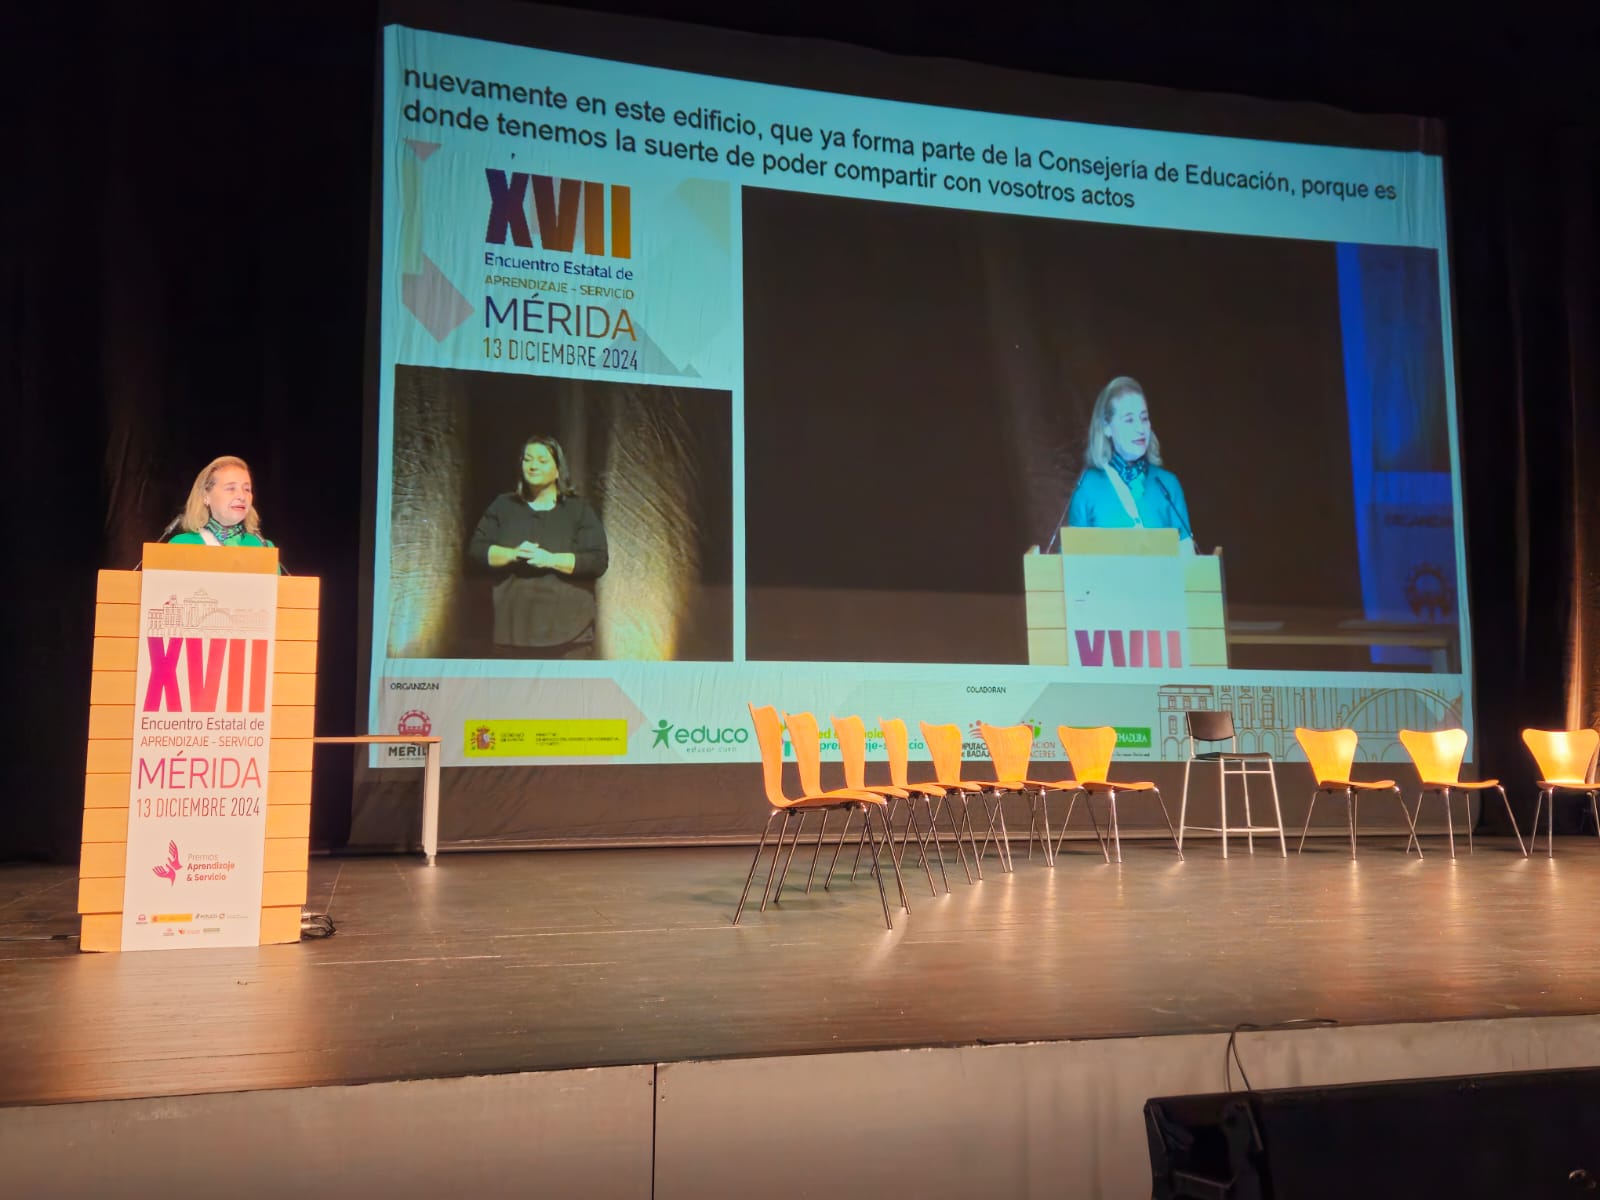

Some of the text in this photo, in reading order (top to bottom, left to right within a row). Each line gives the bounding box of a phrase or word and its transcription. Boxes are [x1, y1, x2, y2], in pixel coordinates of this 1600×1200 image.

[403, 68, 1398, 202] nuevamente en este edificio, que ya forma parte de la Consejería de Educación, porque es
[403, 100, 1136, 208] donde tenemos la suerte de poder compartir con vosotros actos
[484, 168, 632, 259] XVII
[484, 252, 634, 280] Encuentro Estatal de
[484, 275, 569, 294] APRENDIZAJE
[579, 285, 635, 300] SERVICIO
[485, 293, 638, 342] MÉRIDA
[483, 337, 638, 370] 13 DICIEMBRE 2024
[143, 636, 269, 713] XVII
[390, 682, 440, 690] ORGANIZAN
[141, 717, 265, 730] Encuentro Estatal de
[674, 725, 749, 744] educo
[140, 736, 209, 747] APRENDIZAJE
[219, 736, 264, 746] SERVICIO
[137, 750, 262, 789] MÉRIDA
[137, 797, 260, 818] 13 DICIEMBRE 2024
[187, 853, 219, 861] Premios
[187, 861, 235, 872] Aprendizaje
[194, 873, 227, 881] Servicio
